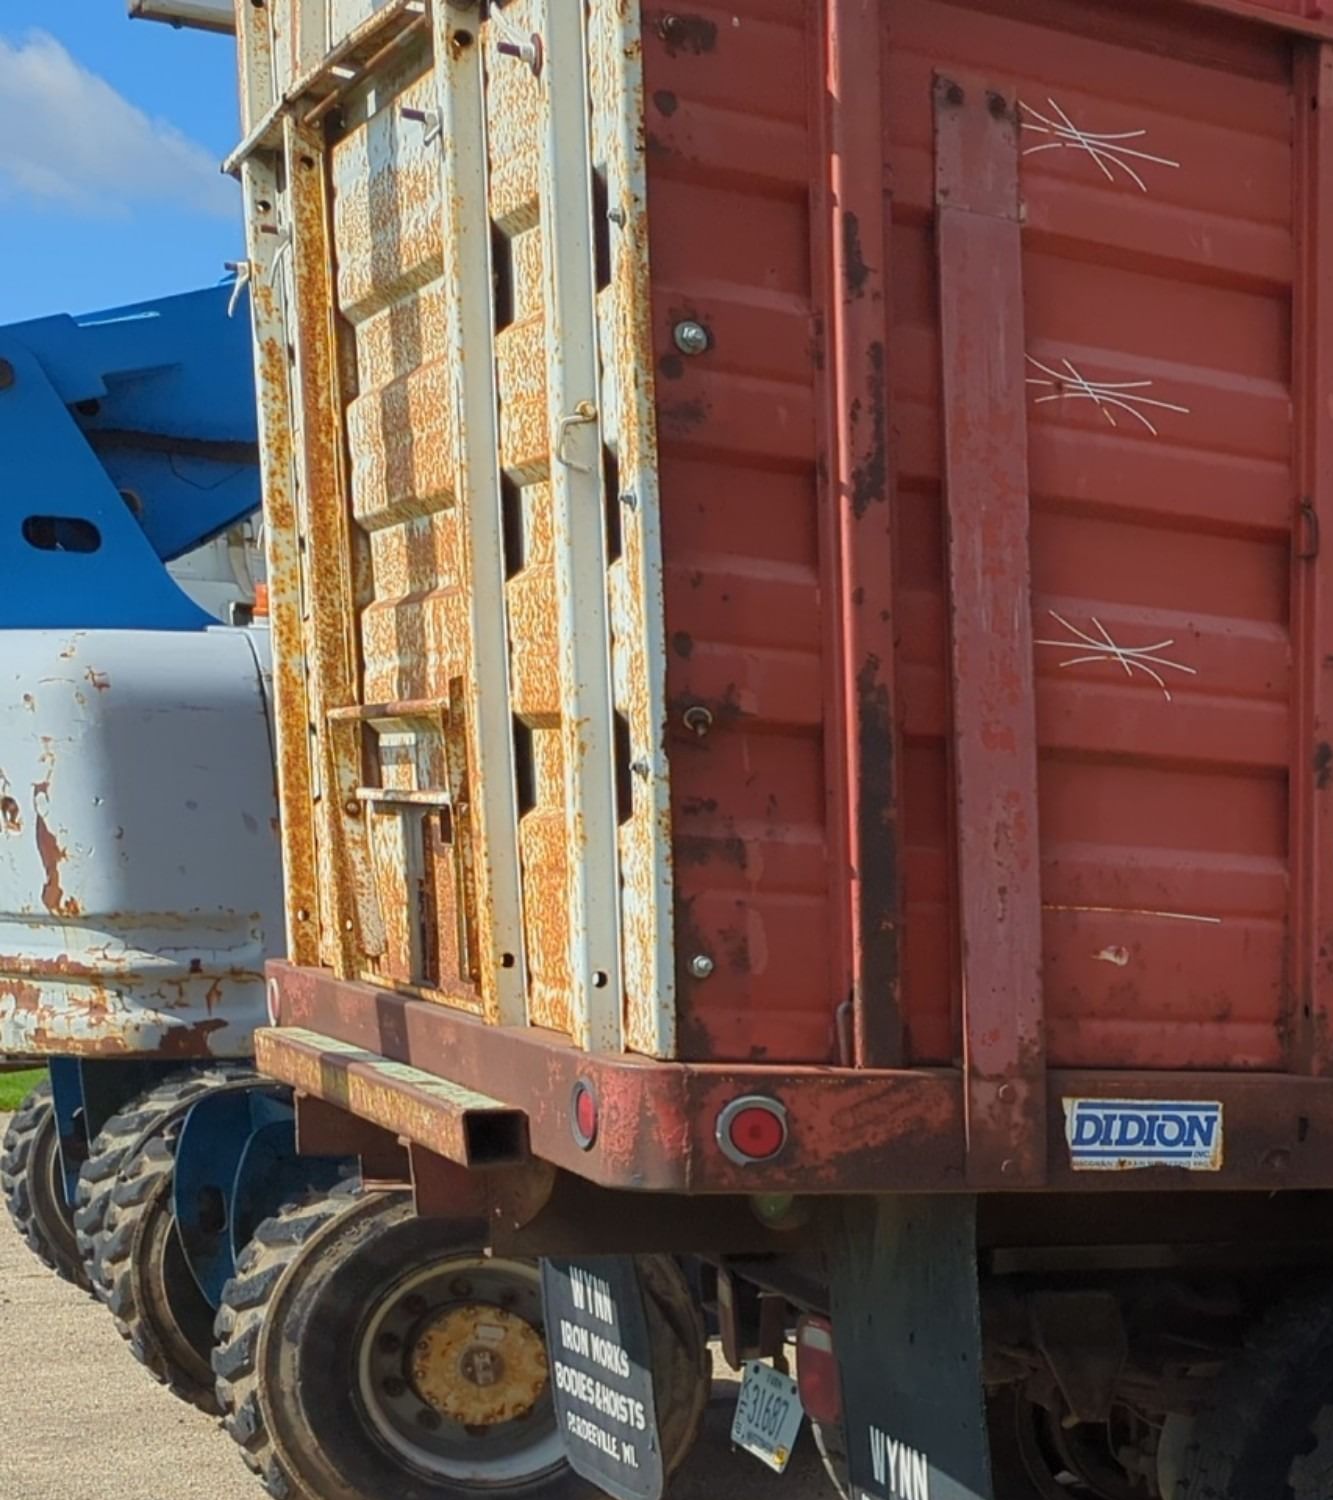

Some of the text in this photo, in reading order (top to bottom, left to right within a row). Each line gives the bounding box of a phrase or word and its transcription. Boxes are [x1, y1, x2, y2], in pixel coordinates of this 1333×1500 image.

[1072, 1114, 1217, 1147] DIDION
[569, 1265, 613, 1325] WYNN
[560, 1319, 630, 1378] IRON WORKS
